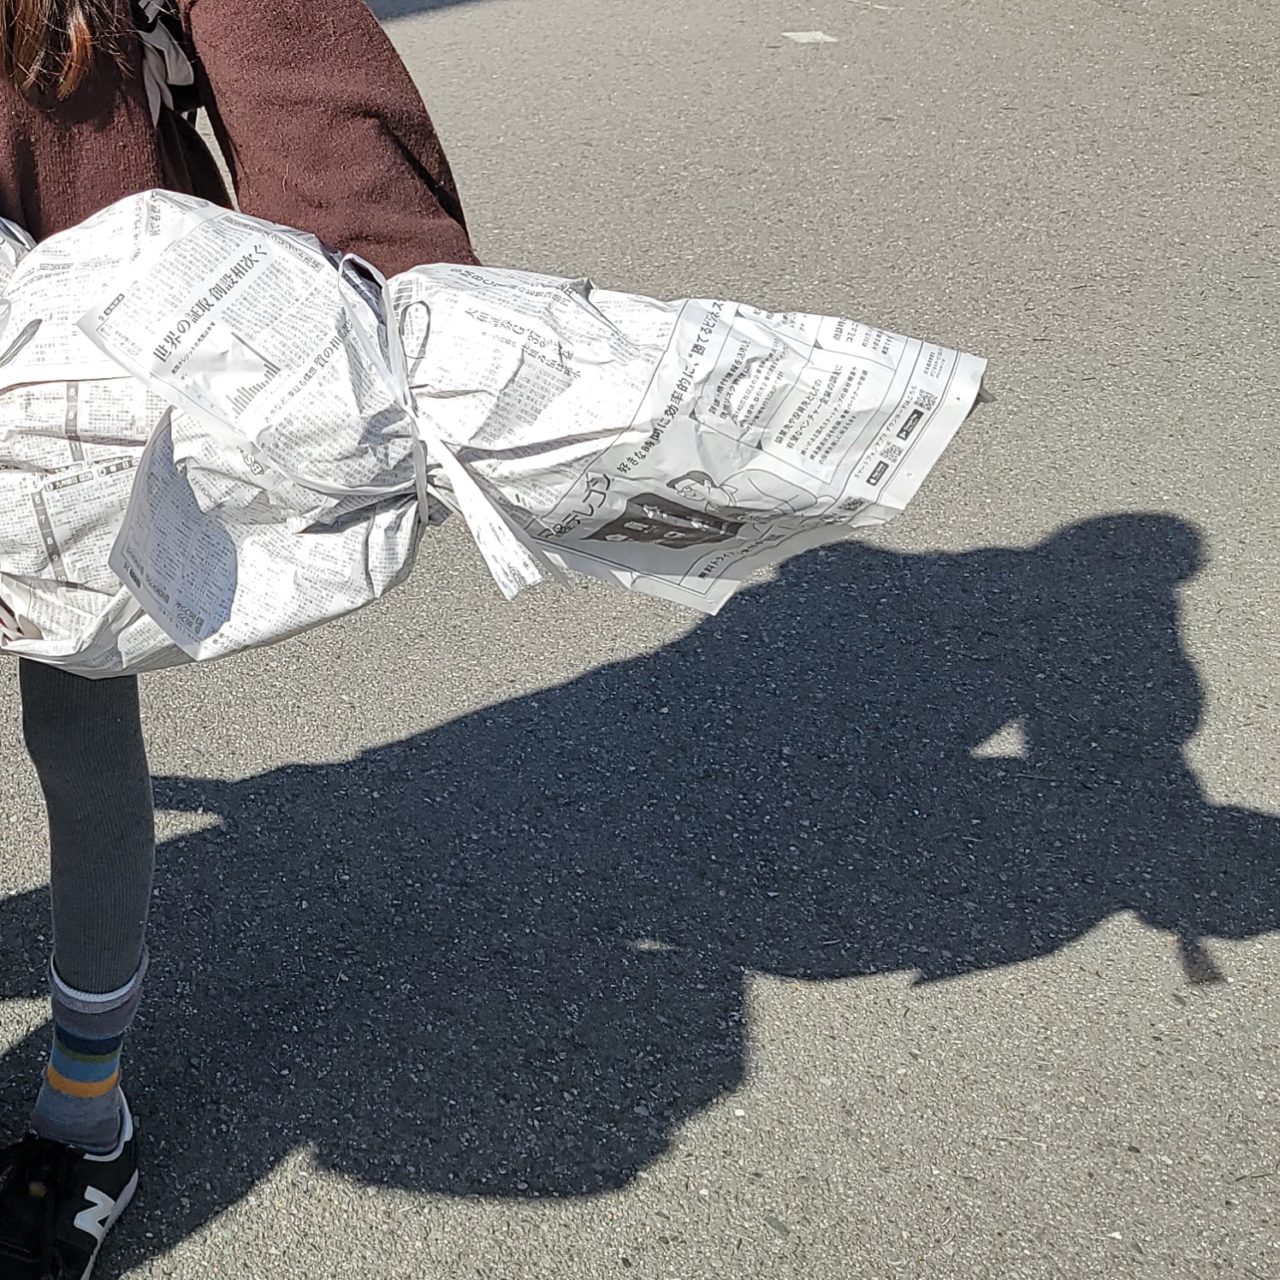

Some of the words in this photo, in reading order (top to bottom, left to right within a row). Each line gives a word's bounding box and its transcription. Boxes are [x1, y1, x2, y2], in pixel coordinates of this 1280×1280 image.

[208, 243, 268, 302] 創設相次ぐ
